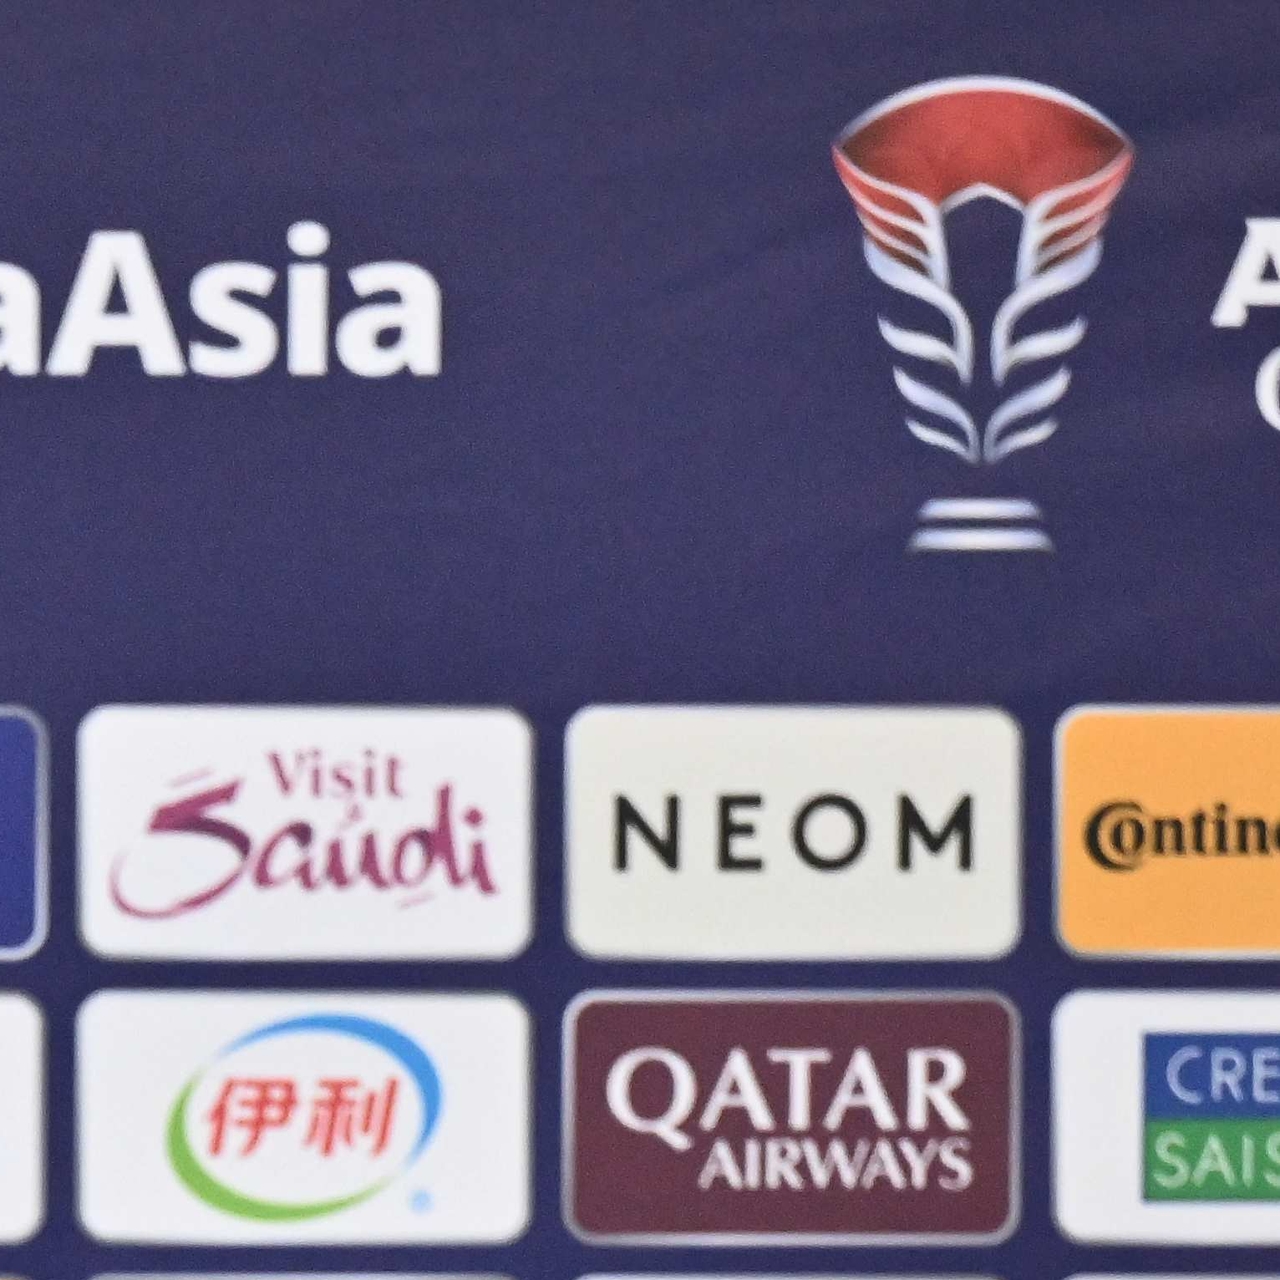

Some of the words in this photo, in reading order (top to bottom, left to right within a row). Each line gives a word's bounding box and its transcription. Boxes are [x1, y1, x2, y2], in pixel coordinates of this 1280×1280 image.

[268, 750, 401, 798] Visit
[111, 782, 497, 920] Saudi
[615, 794, 973, 872] NEOM
[1084, 802, 1280, 871] Contin
[209, 1079, 398, 1156] 伊利
[606, 1046, 970, 1151] QATAR
[698, 1136, 973, 1191] AIRWAYS
